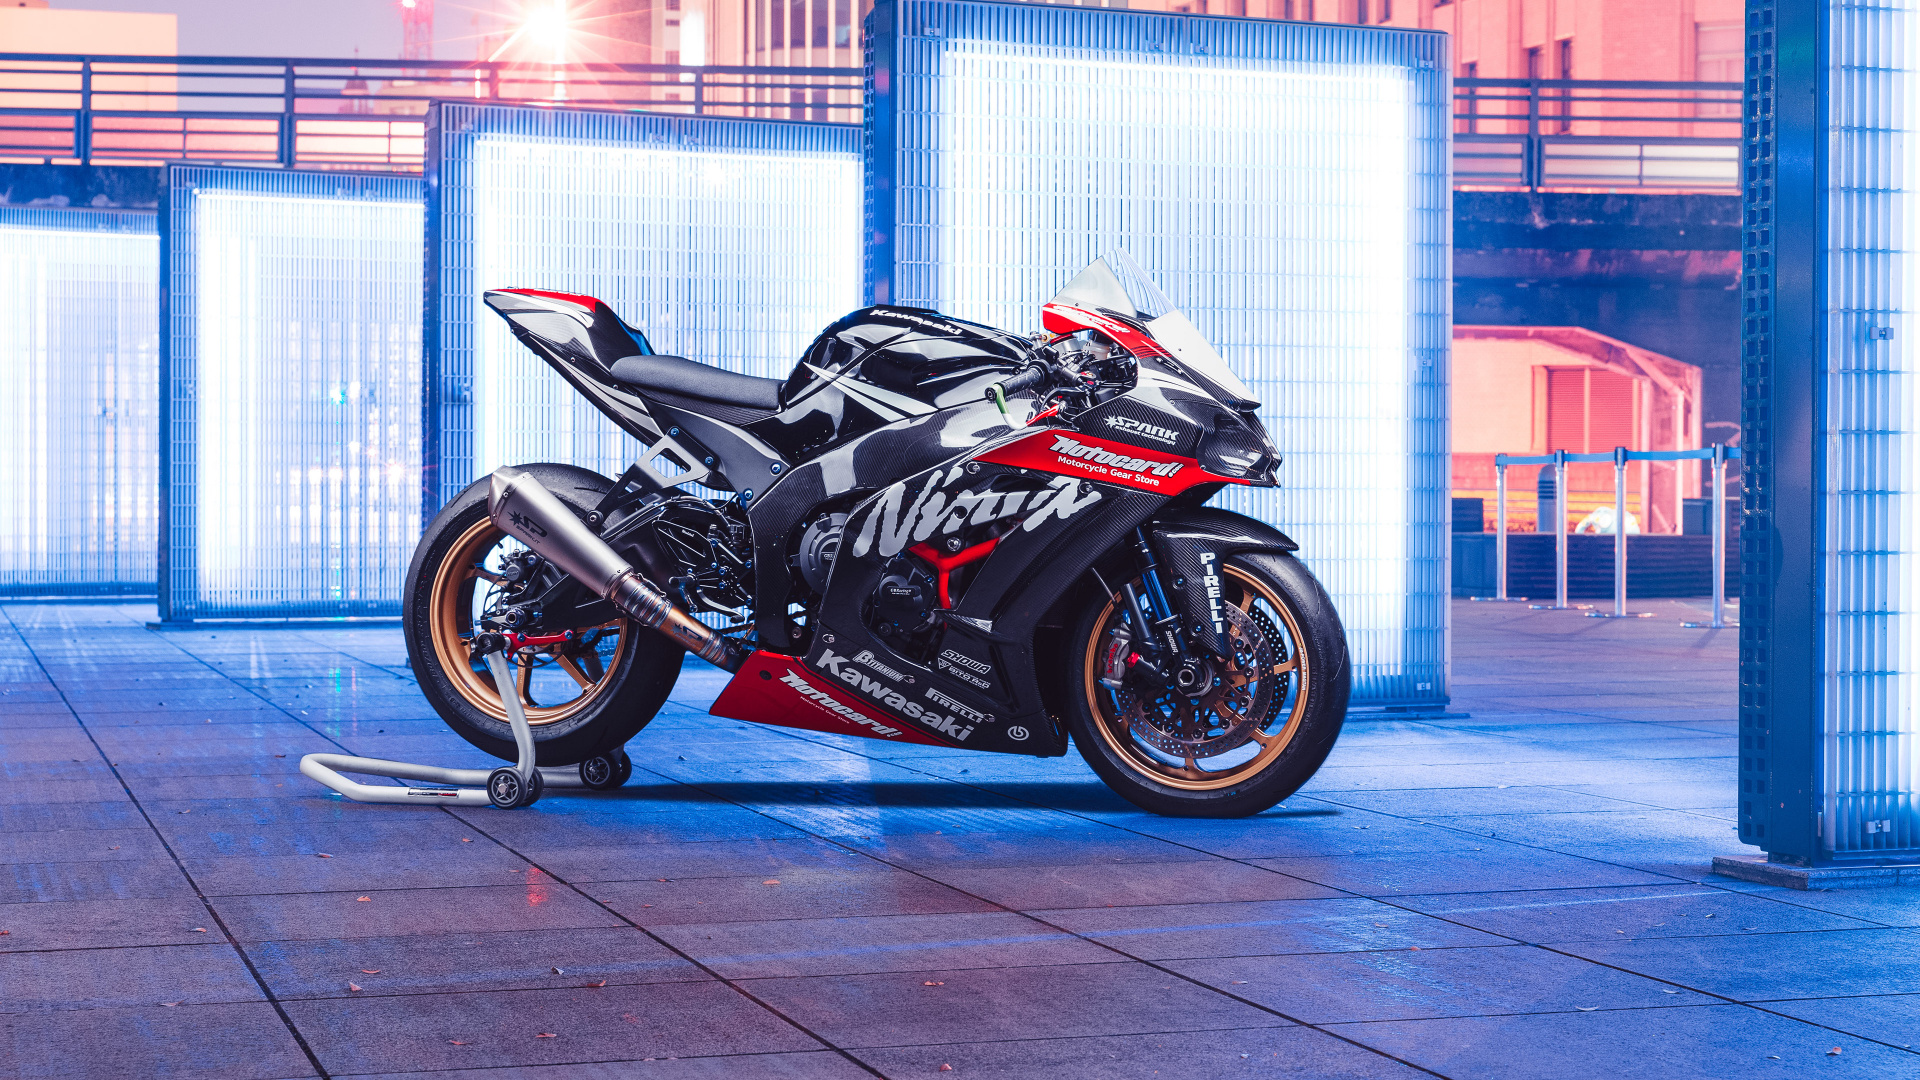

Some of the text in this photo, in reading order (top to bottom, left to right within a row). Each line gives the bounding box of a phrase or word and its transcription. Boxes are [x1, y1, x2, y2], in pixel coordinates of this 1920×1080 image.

[869, 309, 963, 335] Kawasaki
[1115, 416, 1179, 440] SPARK
[1057, 455, 1160, 487] Motorcycle Gear Store
[1200, 552, 1224, 634] PIRELLI
[1165, 630, 1179, 653] SHOWA
[940, 649, 991, 675] SHOWA
[816, 648, 975, 742] Kawasaki
[924, 687, 985, 724] PIRELLI
